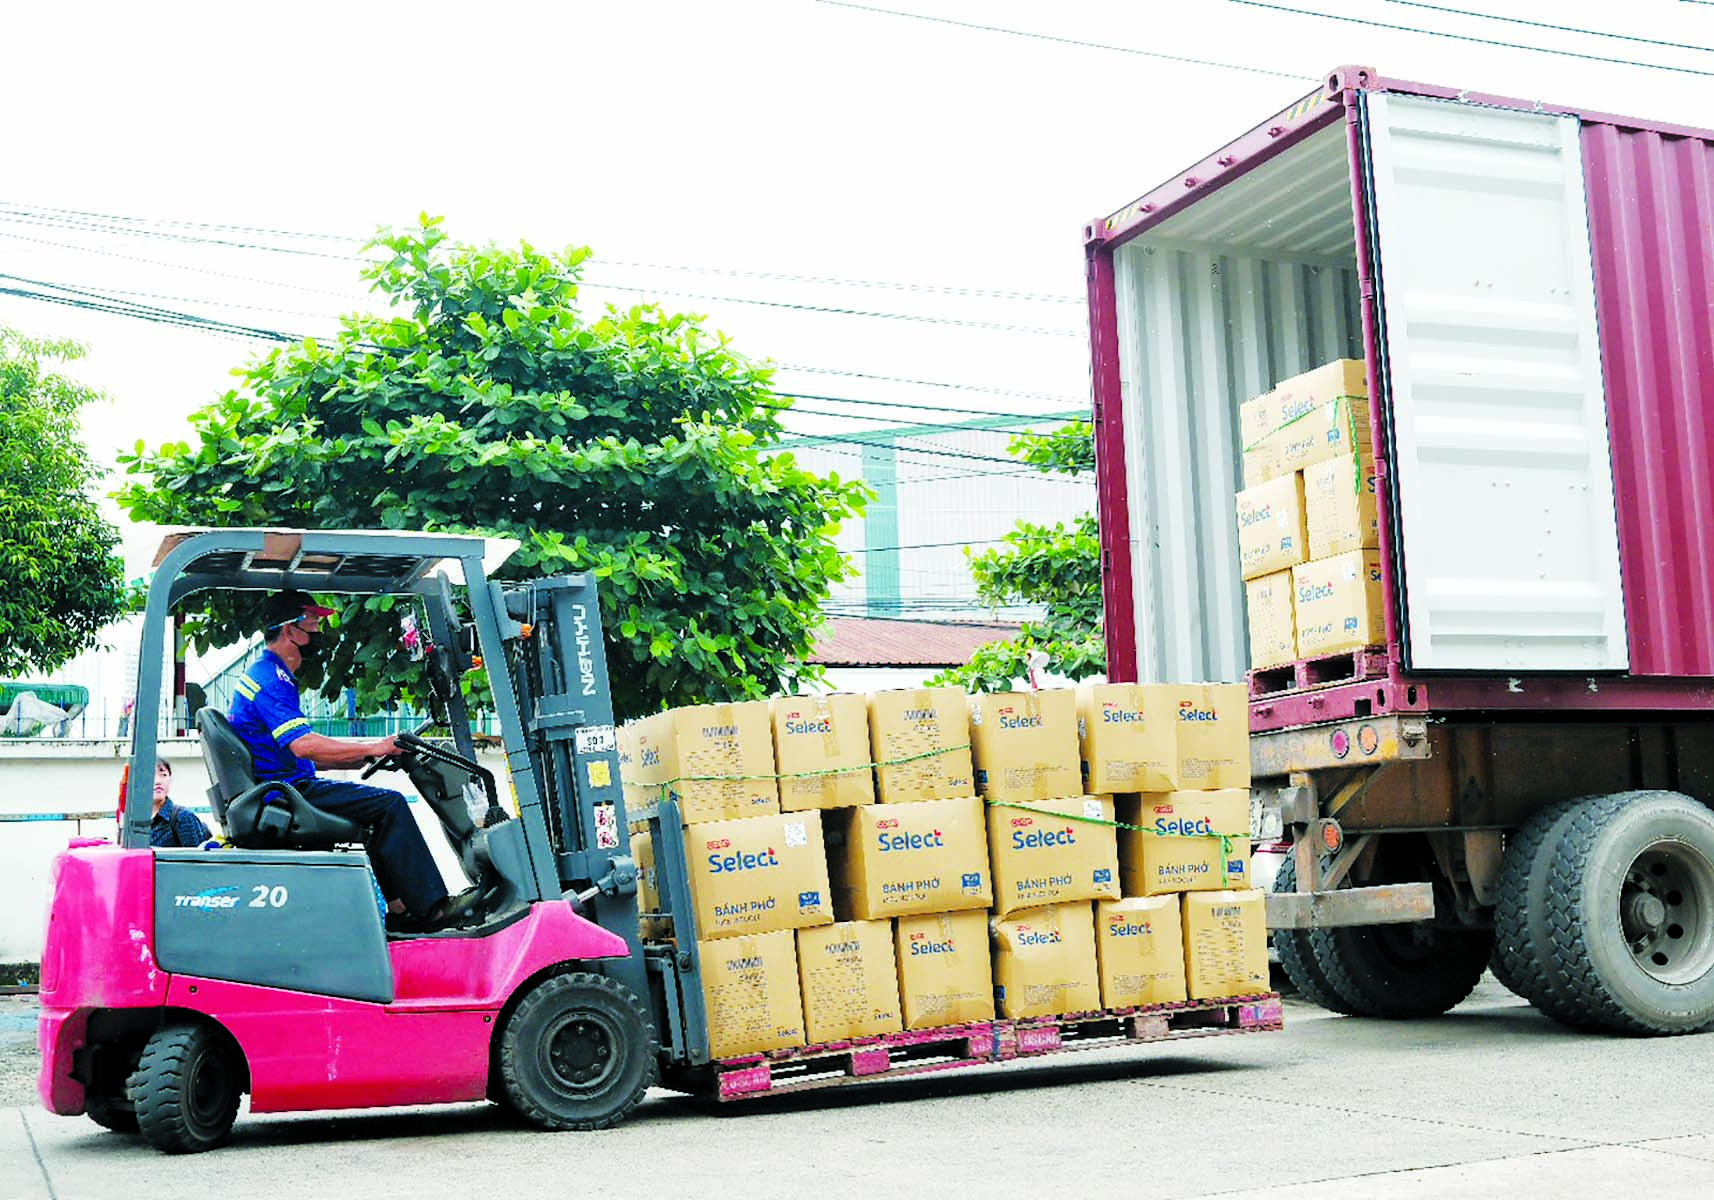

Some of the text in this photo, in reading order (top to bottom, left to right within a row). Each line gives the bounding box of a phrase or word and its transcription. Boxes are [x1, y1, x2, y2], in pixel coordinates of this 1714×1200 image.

[1281, 395, 1316, 420] Select
[1240, 505, 1271, 527] Select
[1299, 582, 1333, 603] Select
[1000, 713, 1044, 729] Select
[1103, 710, 1144, 722] Select
[1179, 708, 1218, 721] Select
[785, 720, 831, 735] Select
[1155, 816, 1213, 836] Select
[878, 829, 943, 852] Select
[1012, 826, 1076, 850] Select
[708, 847, 779, 873] Select
[248, 885, 288, 908] 20
[714, 901, 748, 917] BÁNH
[1110, 922, 1151, 936] Select
[911, 938, 955, 956] Select
